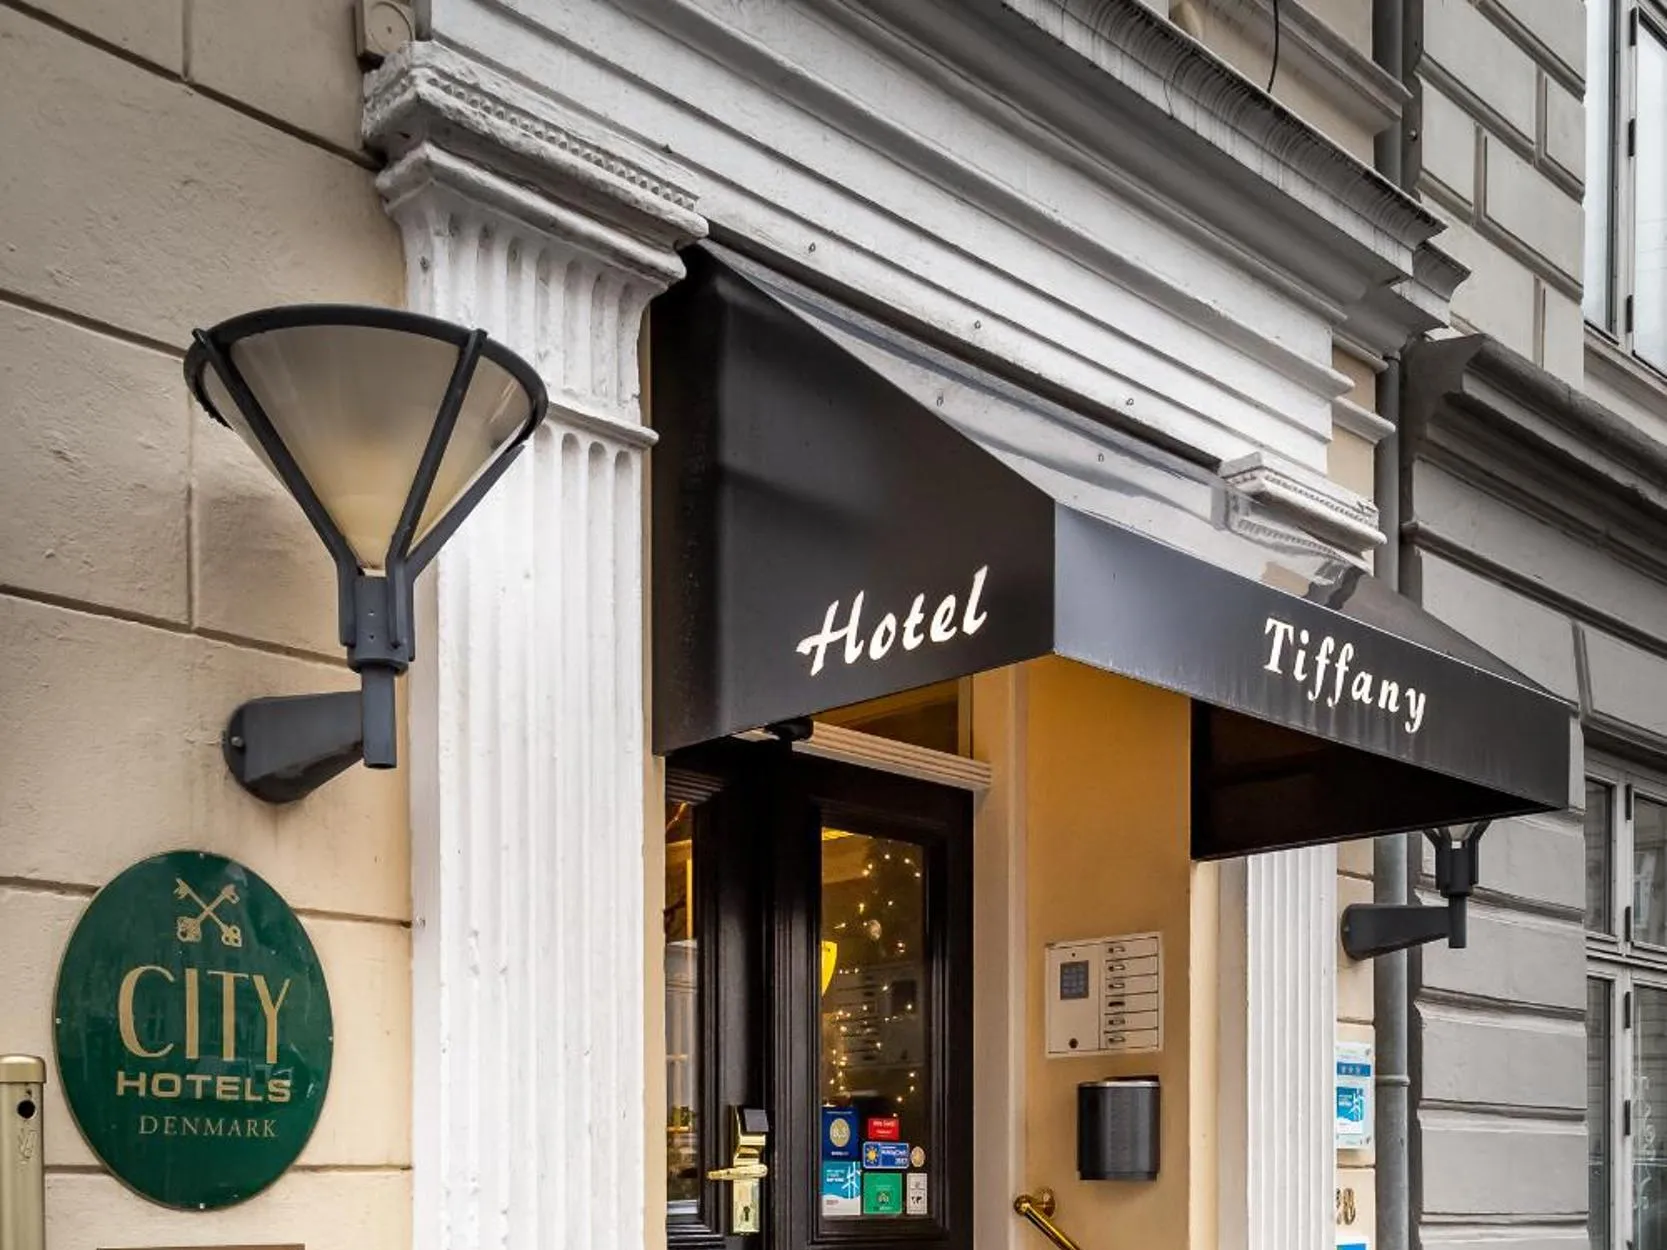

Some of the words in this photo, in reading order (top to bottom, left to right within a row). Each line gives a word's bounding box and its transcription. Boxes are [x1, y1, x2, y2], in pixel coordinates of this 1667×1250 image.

[795, 564, 989, 677] Hotel
[1263, 616, 1427, 733] Tiffany
[118, 964, 291, 1064] CITY
[115, 1070, 293, 1103] HOTELS
[138, 1115, 280, 1138] DENMARK
